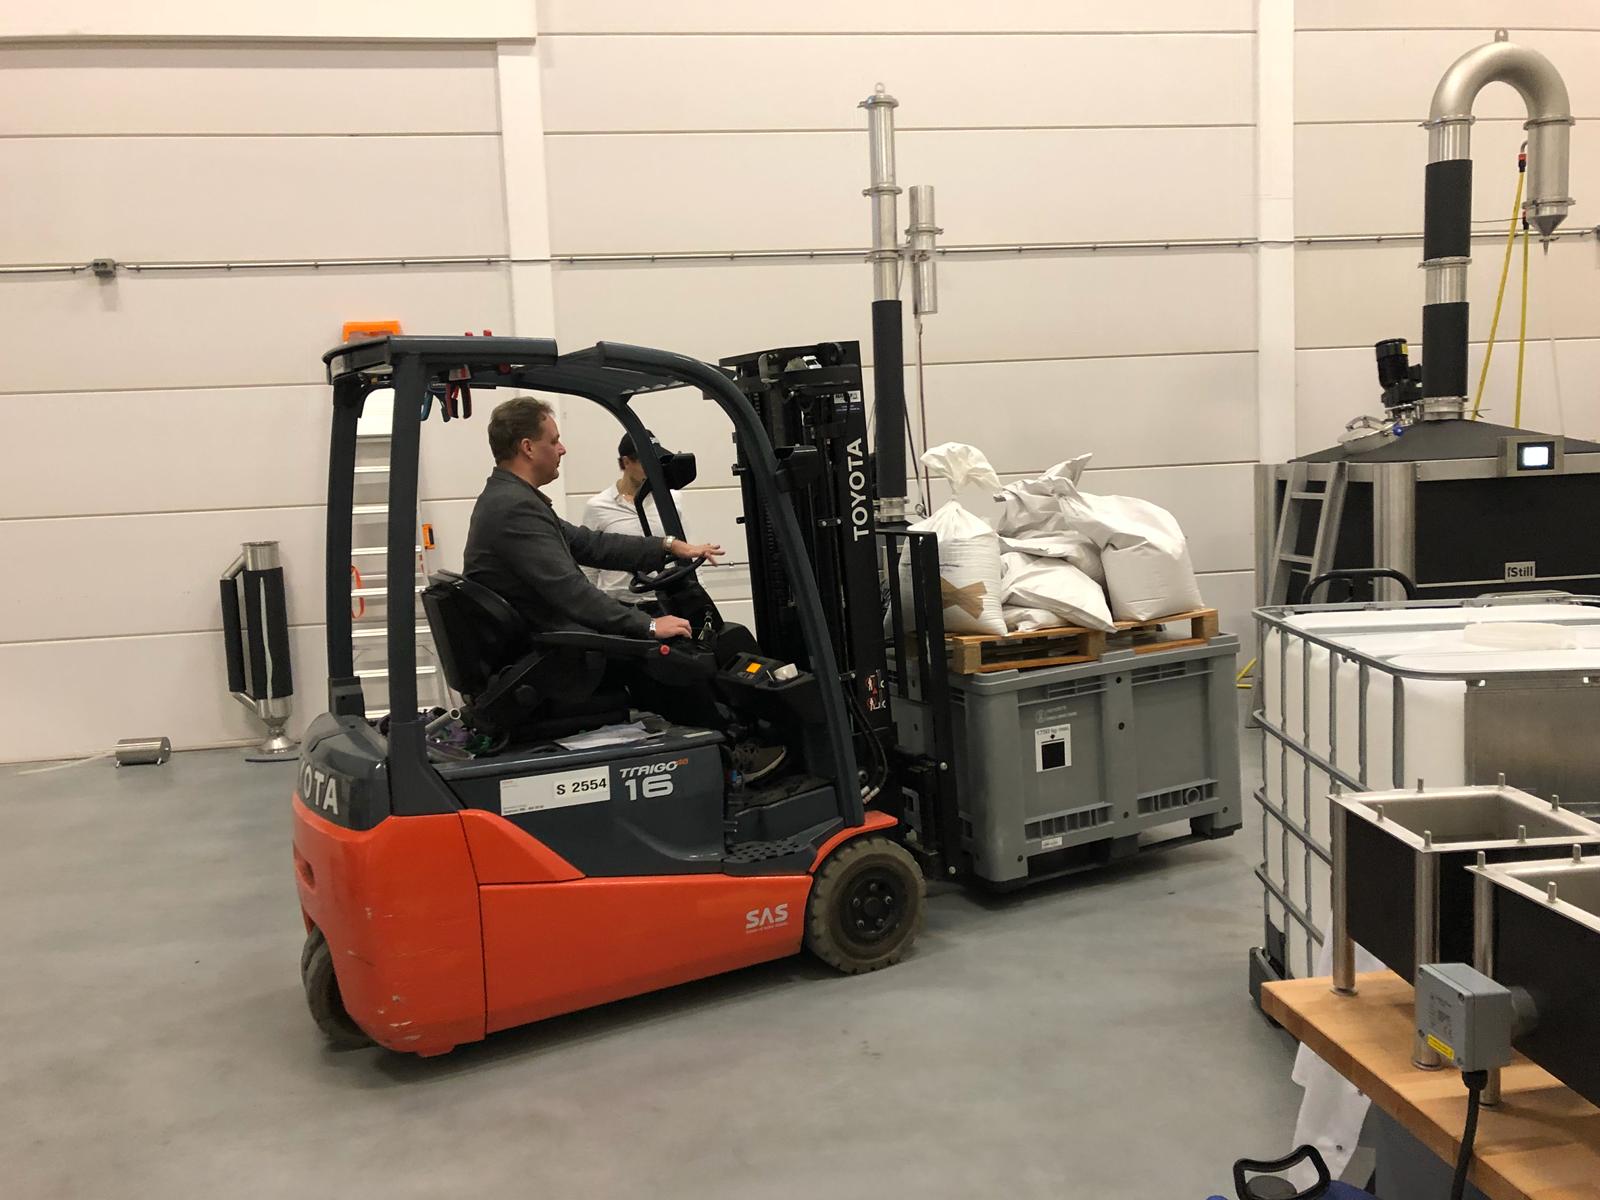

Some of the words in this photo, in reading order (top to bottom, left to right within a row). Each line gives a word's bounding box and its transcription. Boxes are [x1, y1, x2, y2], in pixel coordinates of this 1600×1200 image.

[846, 437, 869, 542] TOYOTA
[300, 761, 339, 815] OTA
[556, 784, 566, 796] S
[571, 778, 607, 793] 2554
[624, 773, 674, 801] 16
[745, 903, 788, 929] SAS
